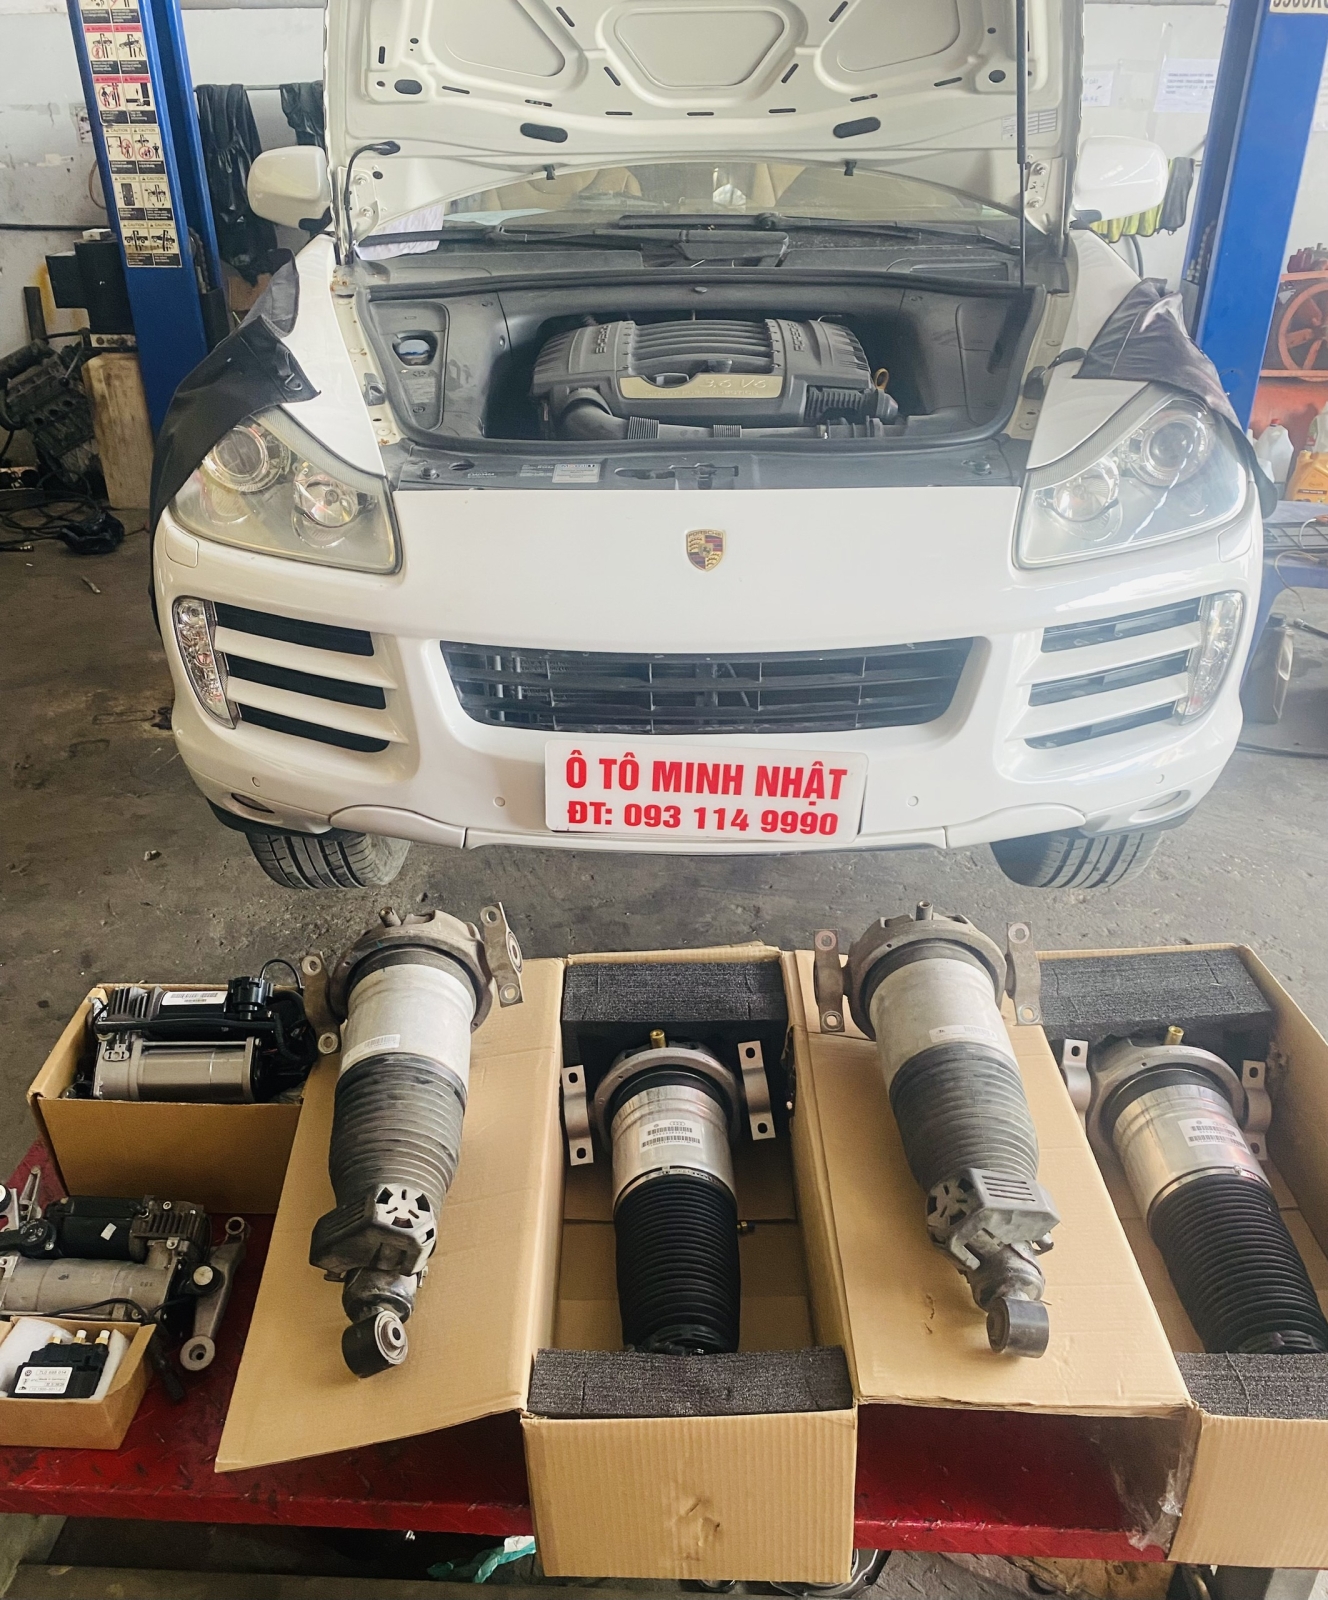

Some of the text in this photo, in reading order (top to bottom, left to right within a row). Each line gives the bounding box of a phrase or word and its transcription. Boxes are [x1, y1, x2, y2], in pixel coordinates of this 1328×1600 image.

[702, 379, 767, 389] 3.6 V6
[566, 750, 847, 806] Ô TÔ MINH NHẬT
[567, 800, 838, 835] ĐT: 093 114 9990
